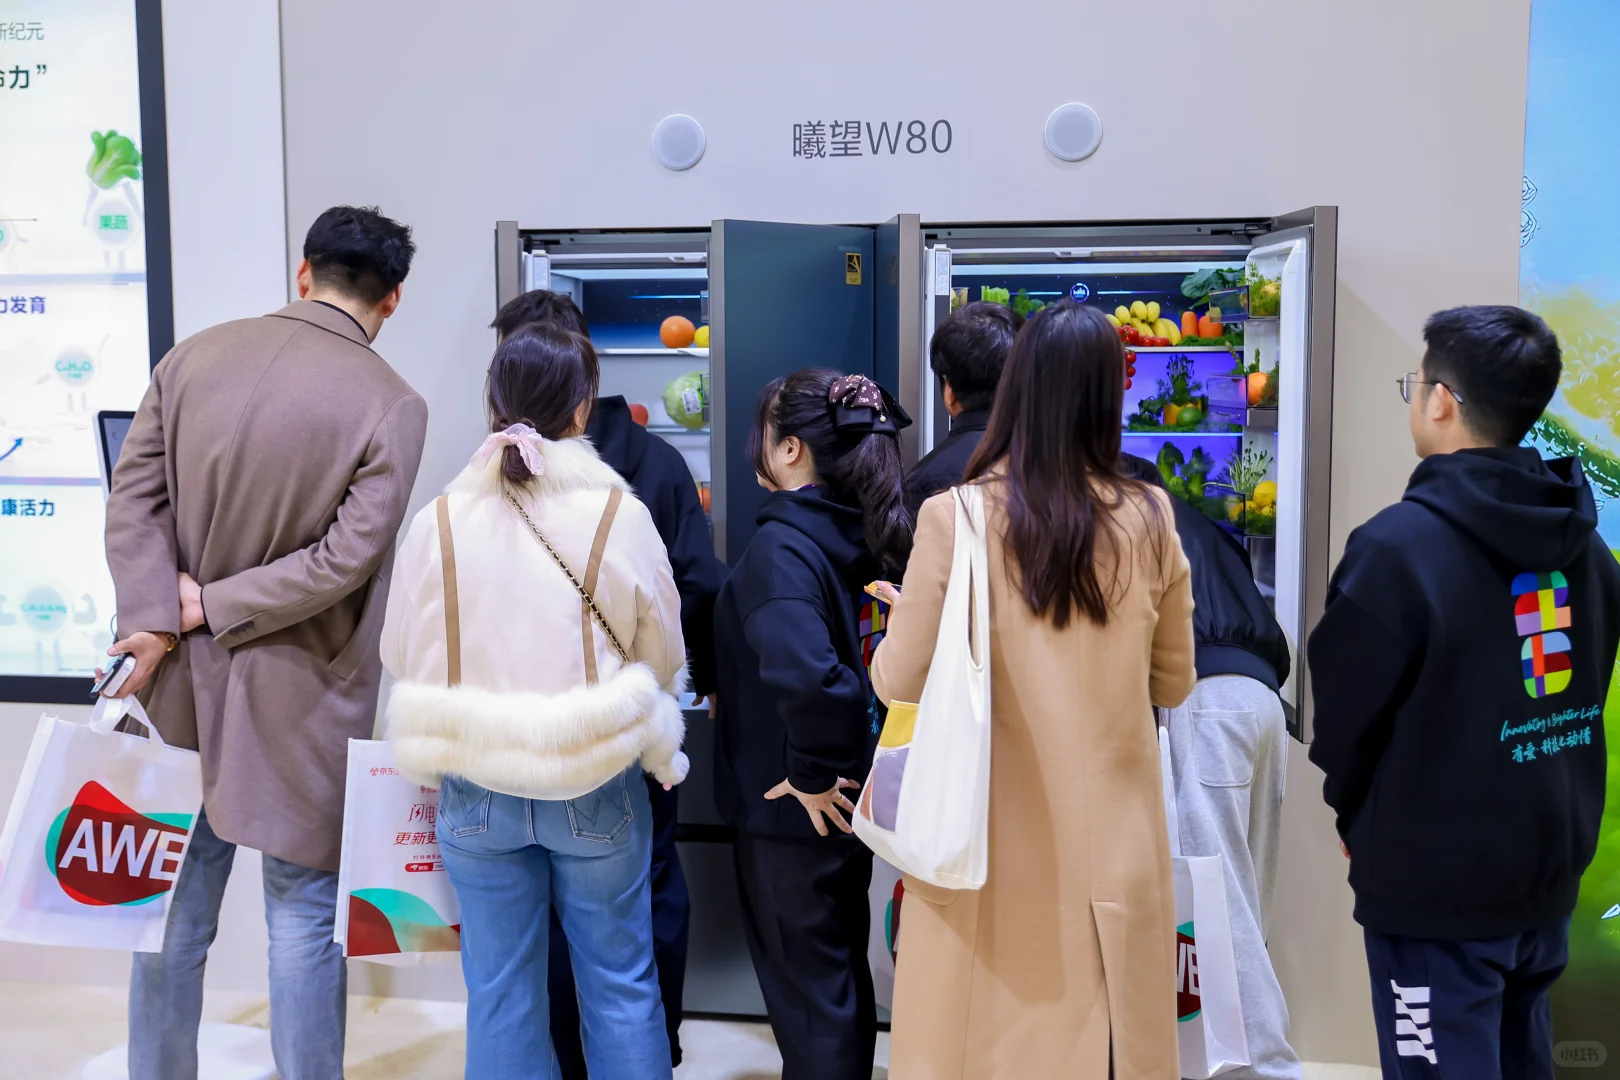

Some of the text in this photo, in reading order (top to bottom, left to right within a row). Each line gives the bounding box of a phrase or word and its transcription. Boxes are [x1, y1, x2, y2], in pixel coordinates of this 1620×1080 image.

[0, 64, 47, 89] 力”
[793, 119, 953, 159] 曦望W80
[1580, 704, 1600, 720] Life
[58, 818, 188, 882] AWE
